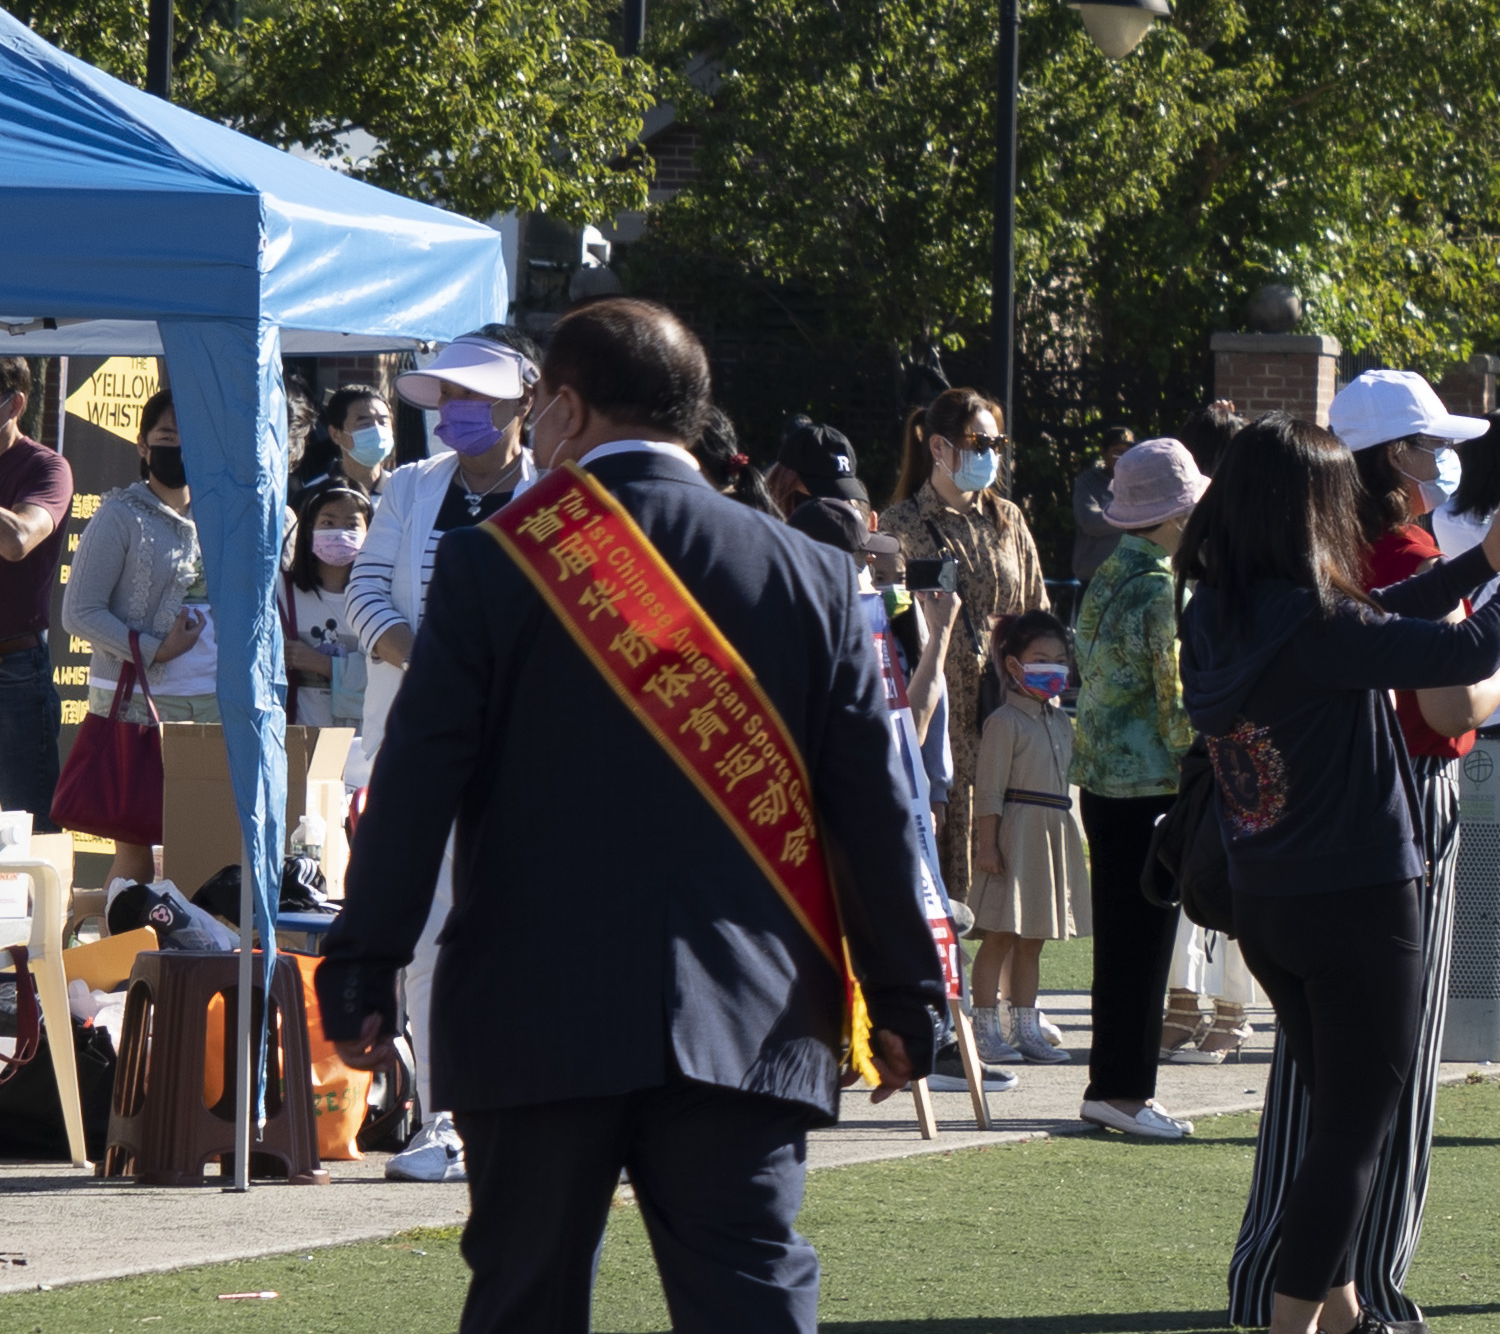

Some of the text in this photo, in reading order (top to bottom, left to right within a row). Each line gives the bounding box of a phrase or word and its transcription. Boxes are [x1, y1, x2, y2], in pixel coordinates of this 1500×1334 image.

[131, 357, 148, 370] THE
[91, 372, 161, 399] YELLOW
[87, 401, 144, 428] WHIST
[837, 455, 850, 472] R
[558, 488, 589, 519] The
[583, 512, 614, 546] 1st
[608, 545, 673, 629] Chinese
[668, 627, 749, 721] American
[743, 715, 791, 784] Sports
[61, 666, 90, 685] WHIST
[516, 503, 811, 867] 首届华侨体育运动会
